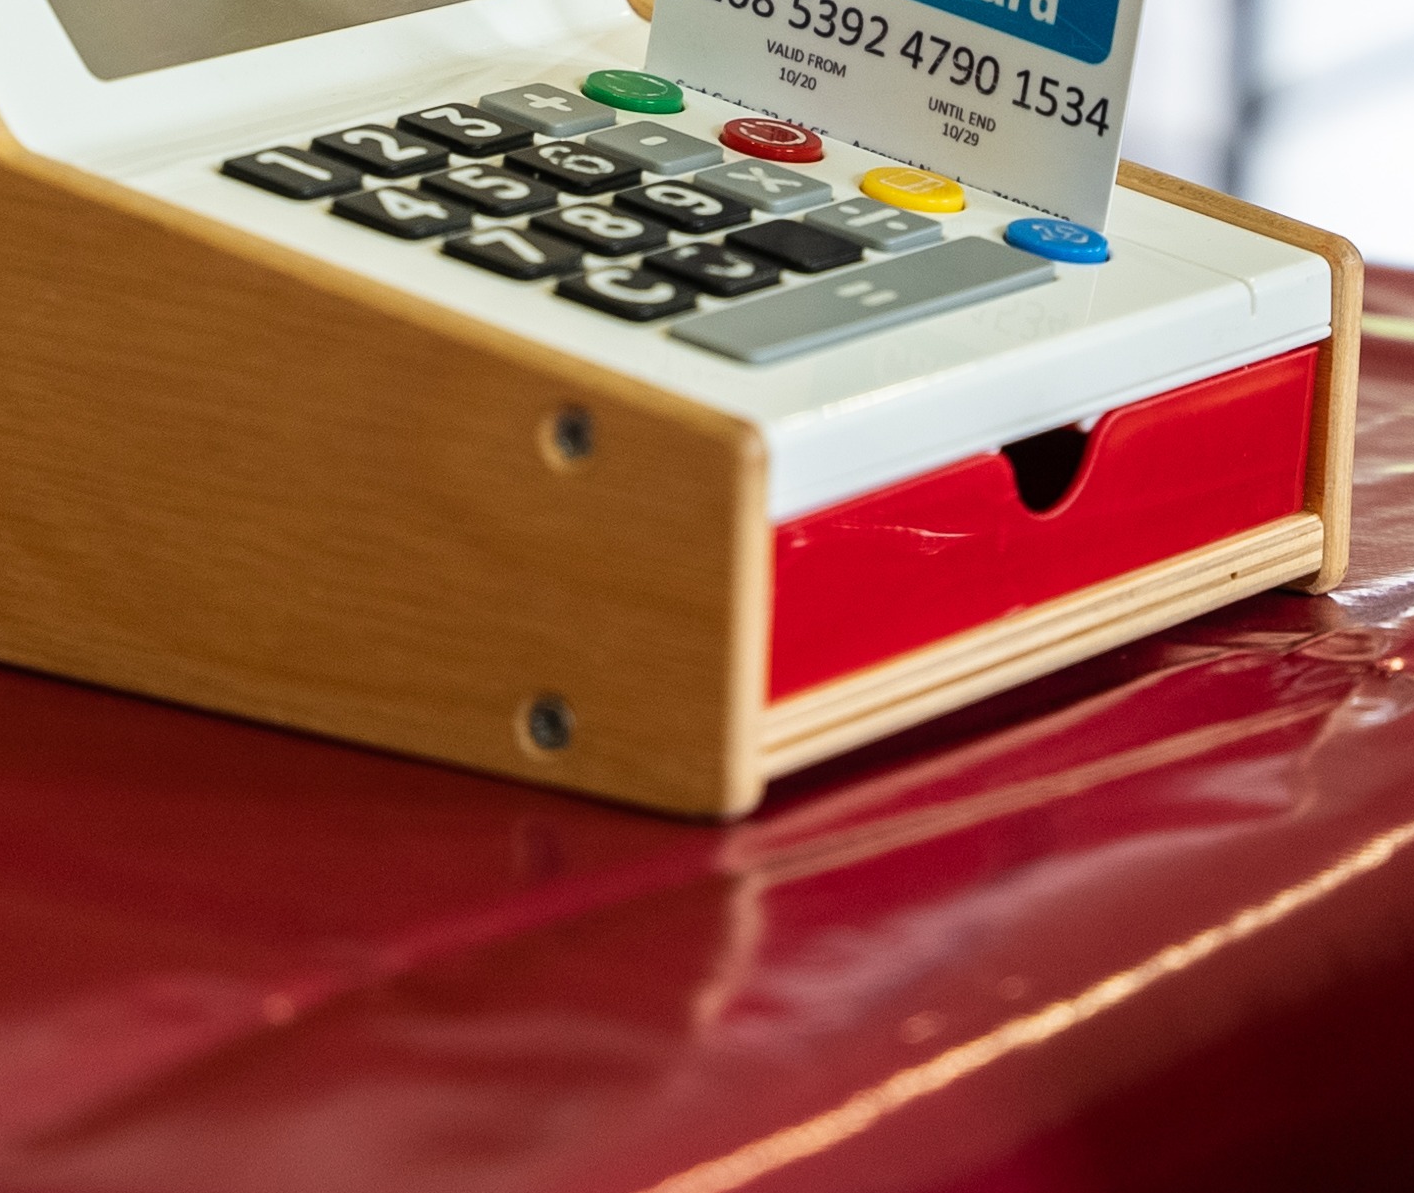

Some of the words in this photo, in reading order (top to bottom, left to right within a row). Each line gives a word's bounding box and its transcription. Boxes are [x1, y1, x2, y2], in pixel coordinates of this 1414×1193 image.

[766, 38, 804, 63] VALID
[807, 53, 847, 78] FROM
[778, 66, 817, 91] 10/20
[900, 30, 1001, 96] 4790
[1012, 69, 1109, 137] 1534
[928, 96, 966, 123] UNTIL
[968, 112, 996, 133] END
[942, 122, 980, 147] 10/29
[256, 151, 332, 181] 1
[343, 129, 428, 161] 2
[420, 107, 502, 137] 3
[376, 187, 449, 220] 4
[447, 166, 530, 199] 5
[538, 145, 615, 175] 6
[470, 227, 547, 264] 7
[561, 207, 644, 239] 8
[645, 184, 723, 216] 9
[588, 266, 676, 304] C
